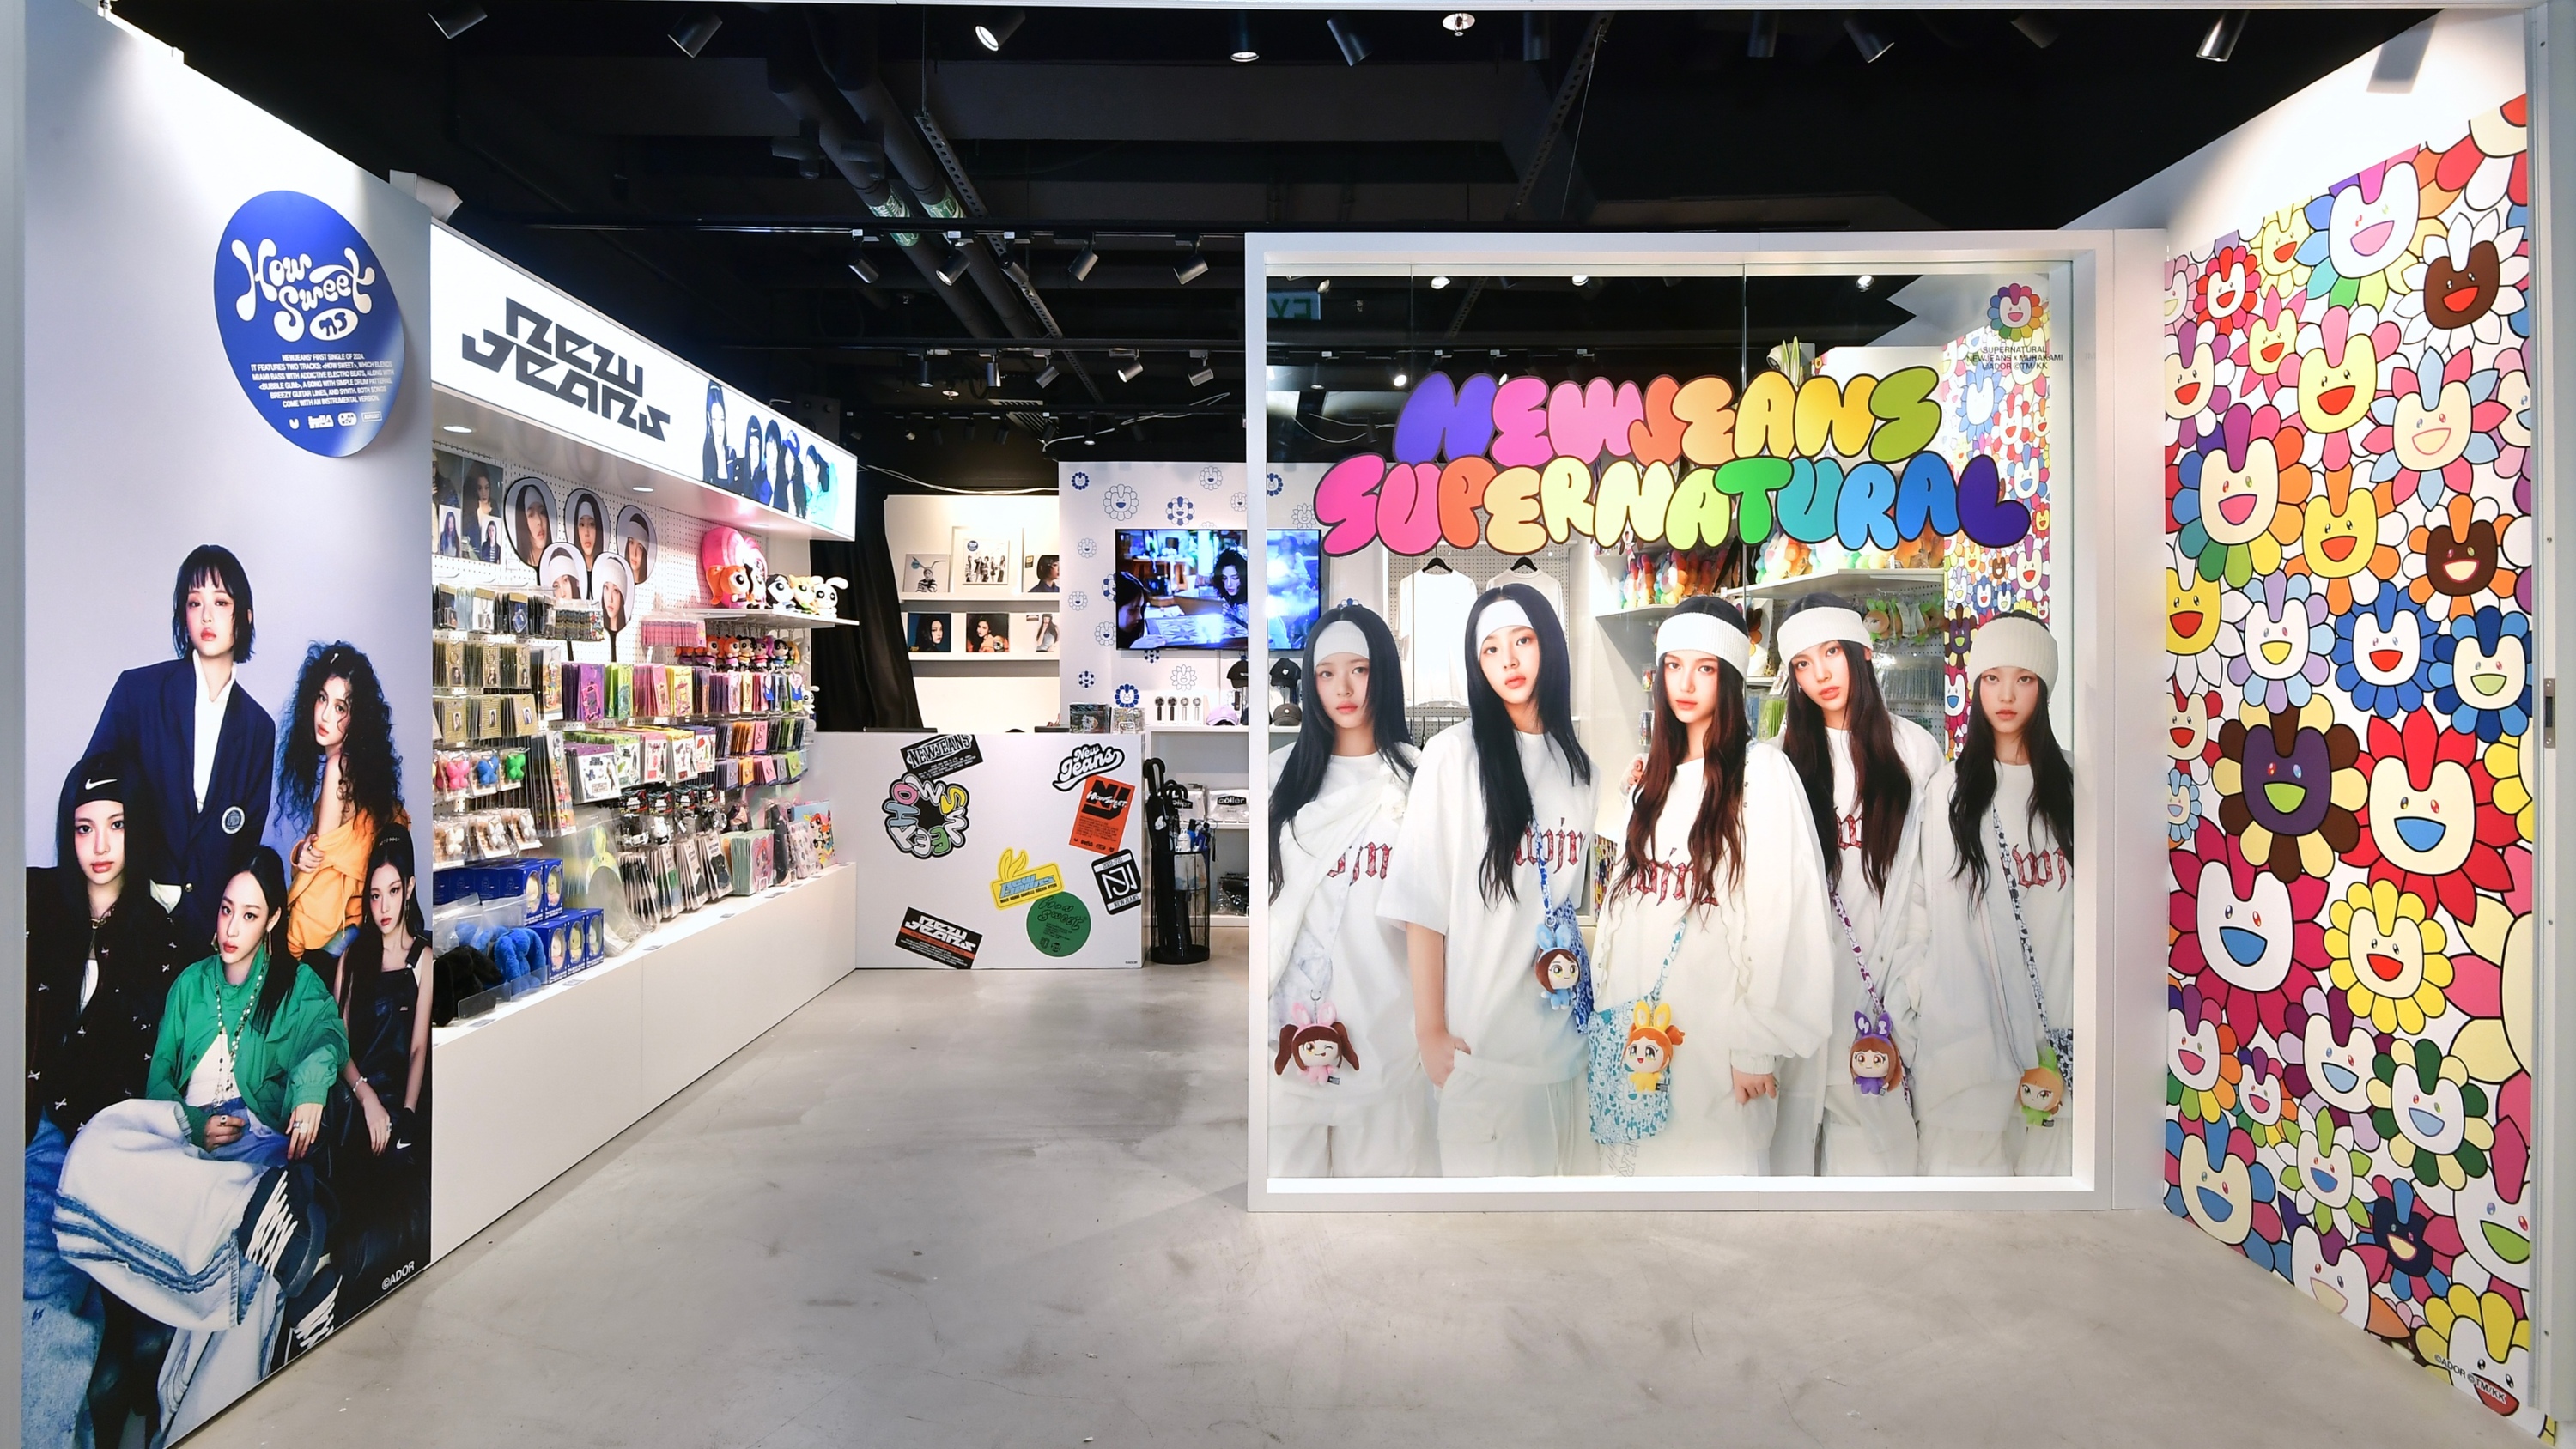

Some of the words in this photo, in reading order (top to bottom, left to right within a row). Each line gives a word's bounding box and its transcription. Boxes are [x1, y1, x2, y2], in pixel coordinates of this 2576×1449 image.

[231, 238, 313, 322] How
[274, 247, 375, 342] Sweet
[1394, 367, 1941, 467] NEWJEANS
[1314, 452, 2031, 556] SUPERNATURAL
[908, 734, 971, 769] NEWJEANS
[1059, 749, 1115, 782] Jeans
[1073, 745, 1099, 762] New
[381, 1260, 415, 1290] ©ADOR
[2434, 1354, 2466, 1379] ©ADOR
[2466, 1373, 2507, 1404] ©TM/KK
